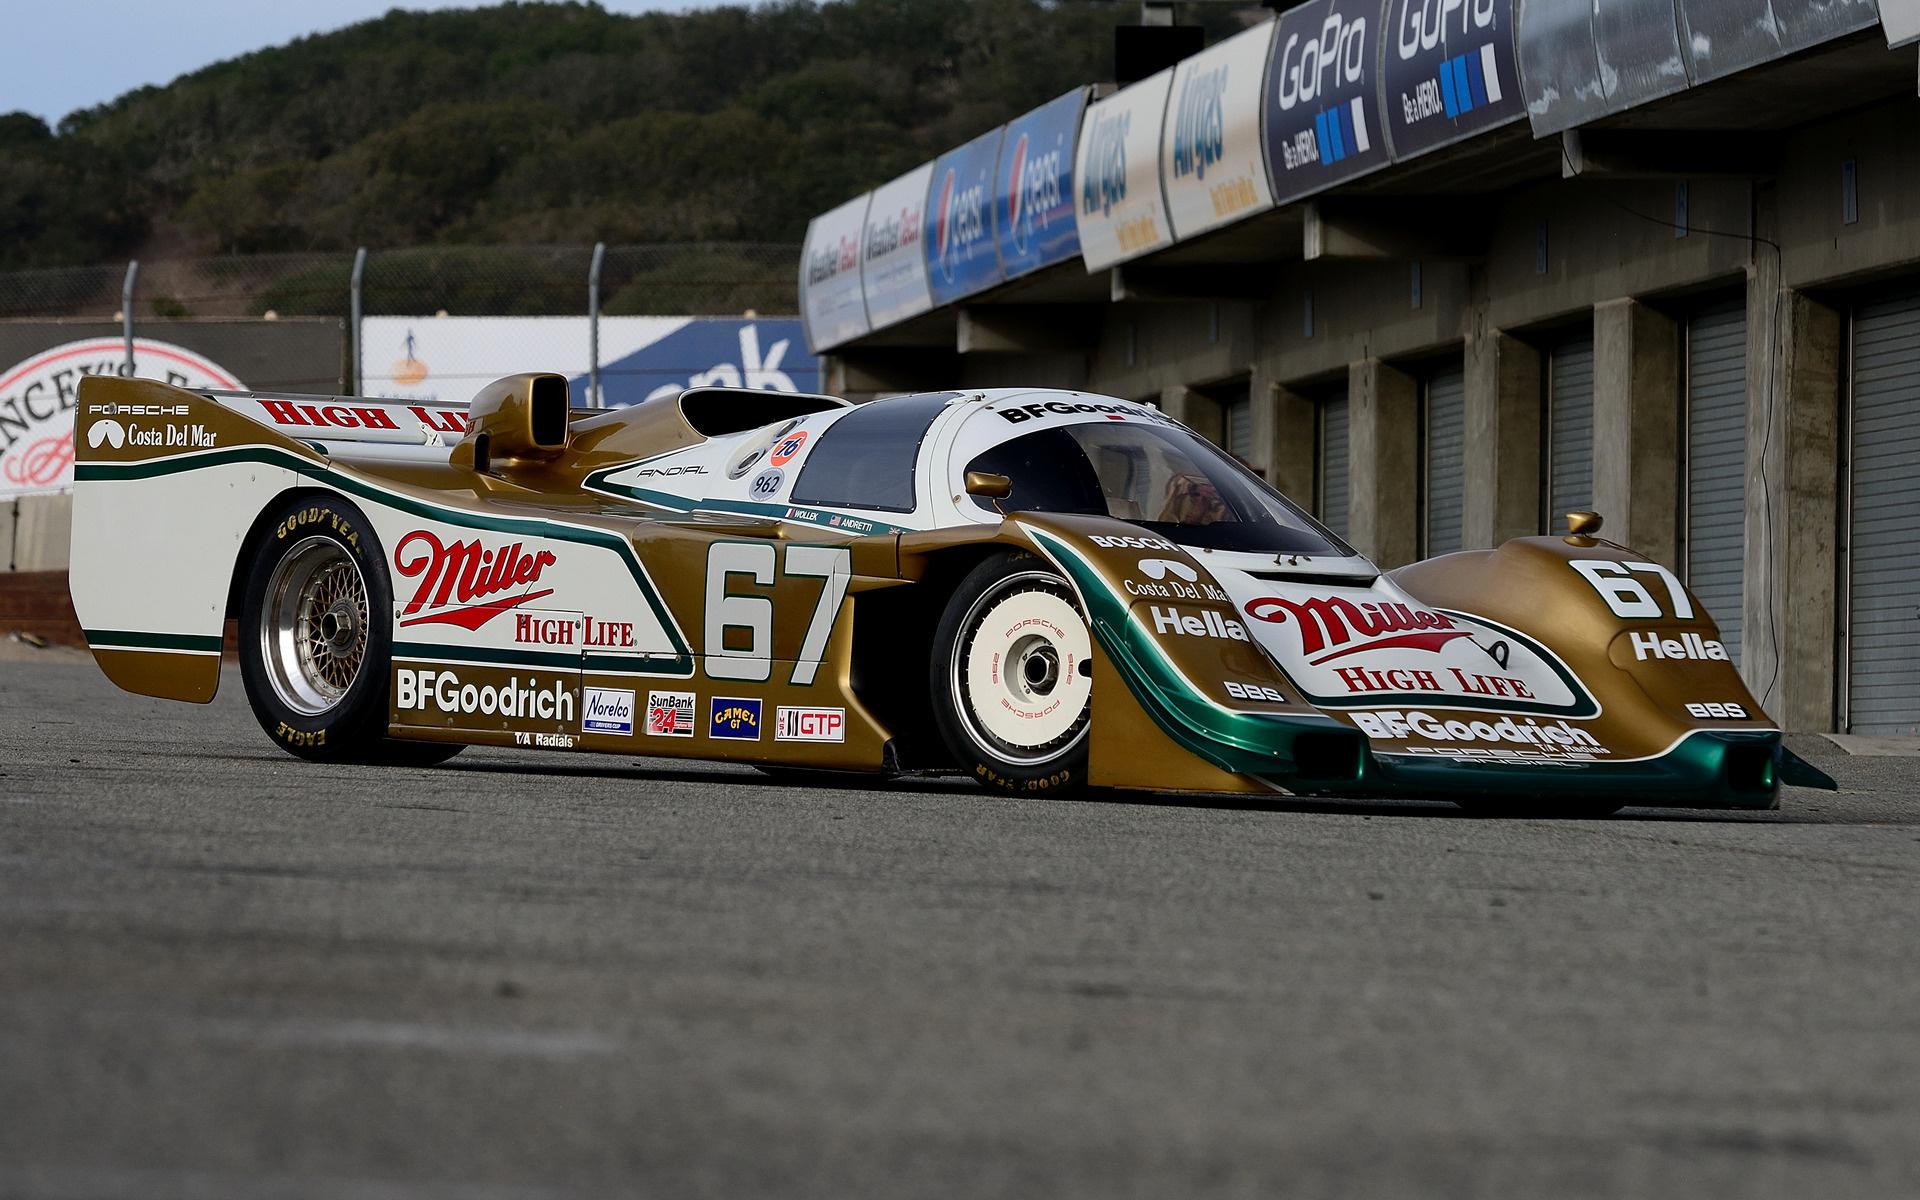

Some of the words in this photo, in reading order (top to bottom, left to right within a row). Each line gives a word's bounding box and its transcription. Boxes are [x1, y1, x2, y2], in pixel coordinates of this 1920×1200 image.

[1279, 13, 1366, 111] GoPro
[1402, 92, 1414, 125] Be
[1282, 141, 1294, 170] Be
[89, 405, 189, 416] PORSCHE
[256, 400, 400, 430] HIGH
[407, 406, 469, 433] LI
[128, 424, 162, 446] Costa
[166, 424, 188, 447] Del
[191, 424, 216, 447] Mar
[775, 437, 804, 456] 76
[637, 465, 709, 478] ANDIAL
[754, 476, 780, 493] 962
[841, 519, 873, 532] ANDRETTI
[1088, 535, 1180, 551] BOSCH
[394, 529, 557, 615] Miller
[1124, 580, 1170, 597] Costa
[1169, 581, 1201, 599] Del
[1568, 559, 1694, 619] 67
[704, 540, 851, 686] 67
[1150, 606, 1251, 642] Hella
[515, 612, 574, 645] HIGH
[583, 616, 635, 647] LIFE
[1005, 618, 1065, 639] PORSCHE
[1244, 596, 1458, 656] Miller
[1629, 632, 1731, 661] Hella
[1223, 681, 1285, 702] BBS
[1333, 666, 1445, 692] HIGH
[1447, 667, 1536, 699] LIFE
[397, 669, 575, 721] BFGoodrich
[586, 692, 629, 719] Norelco
[650, 694, 694, 709] SunBank
[652, 708, 677, 733] 24
[715, 707, 756, 726] CAMEL
[1001, 698, 1061, 719] PORSCHE
[1684, 702, 1747, 718] BBS
[276, 721, 327, 746] EAGLE
[730, 719, 741, 729] GT
[800, 713, 841, 735] GTP
[1348, 711, 1602, 746] BFGoodrich
[514, 732, 531, 745] T/A
[536, 733, 573, 748] Radials
